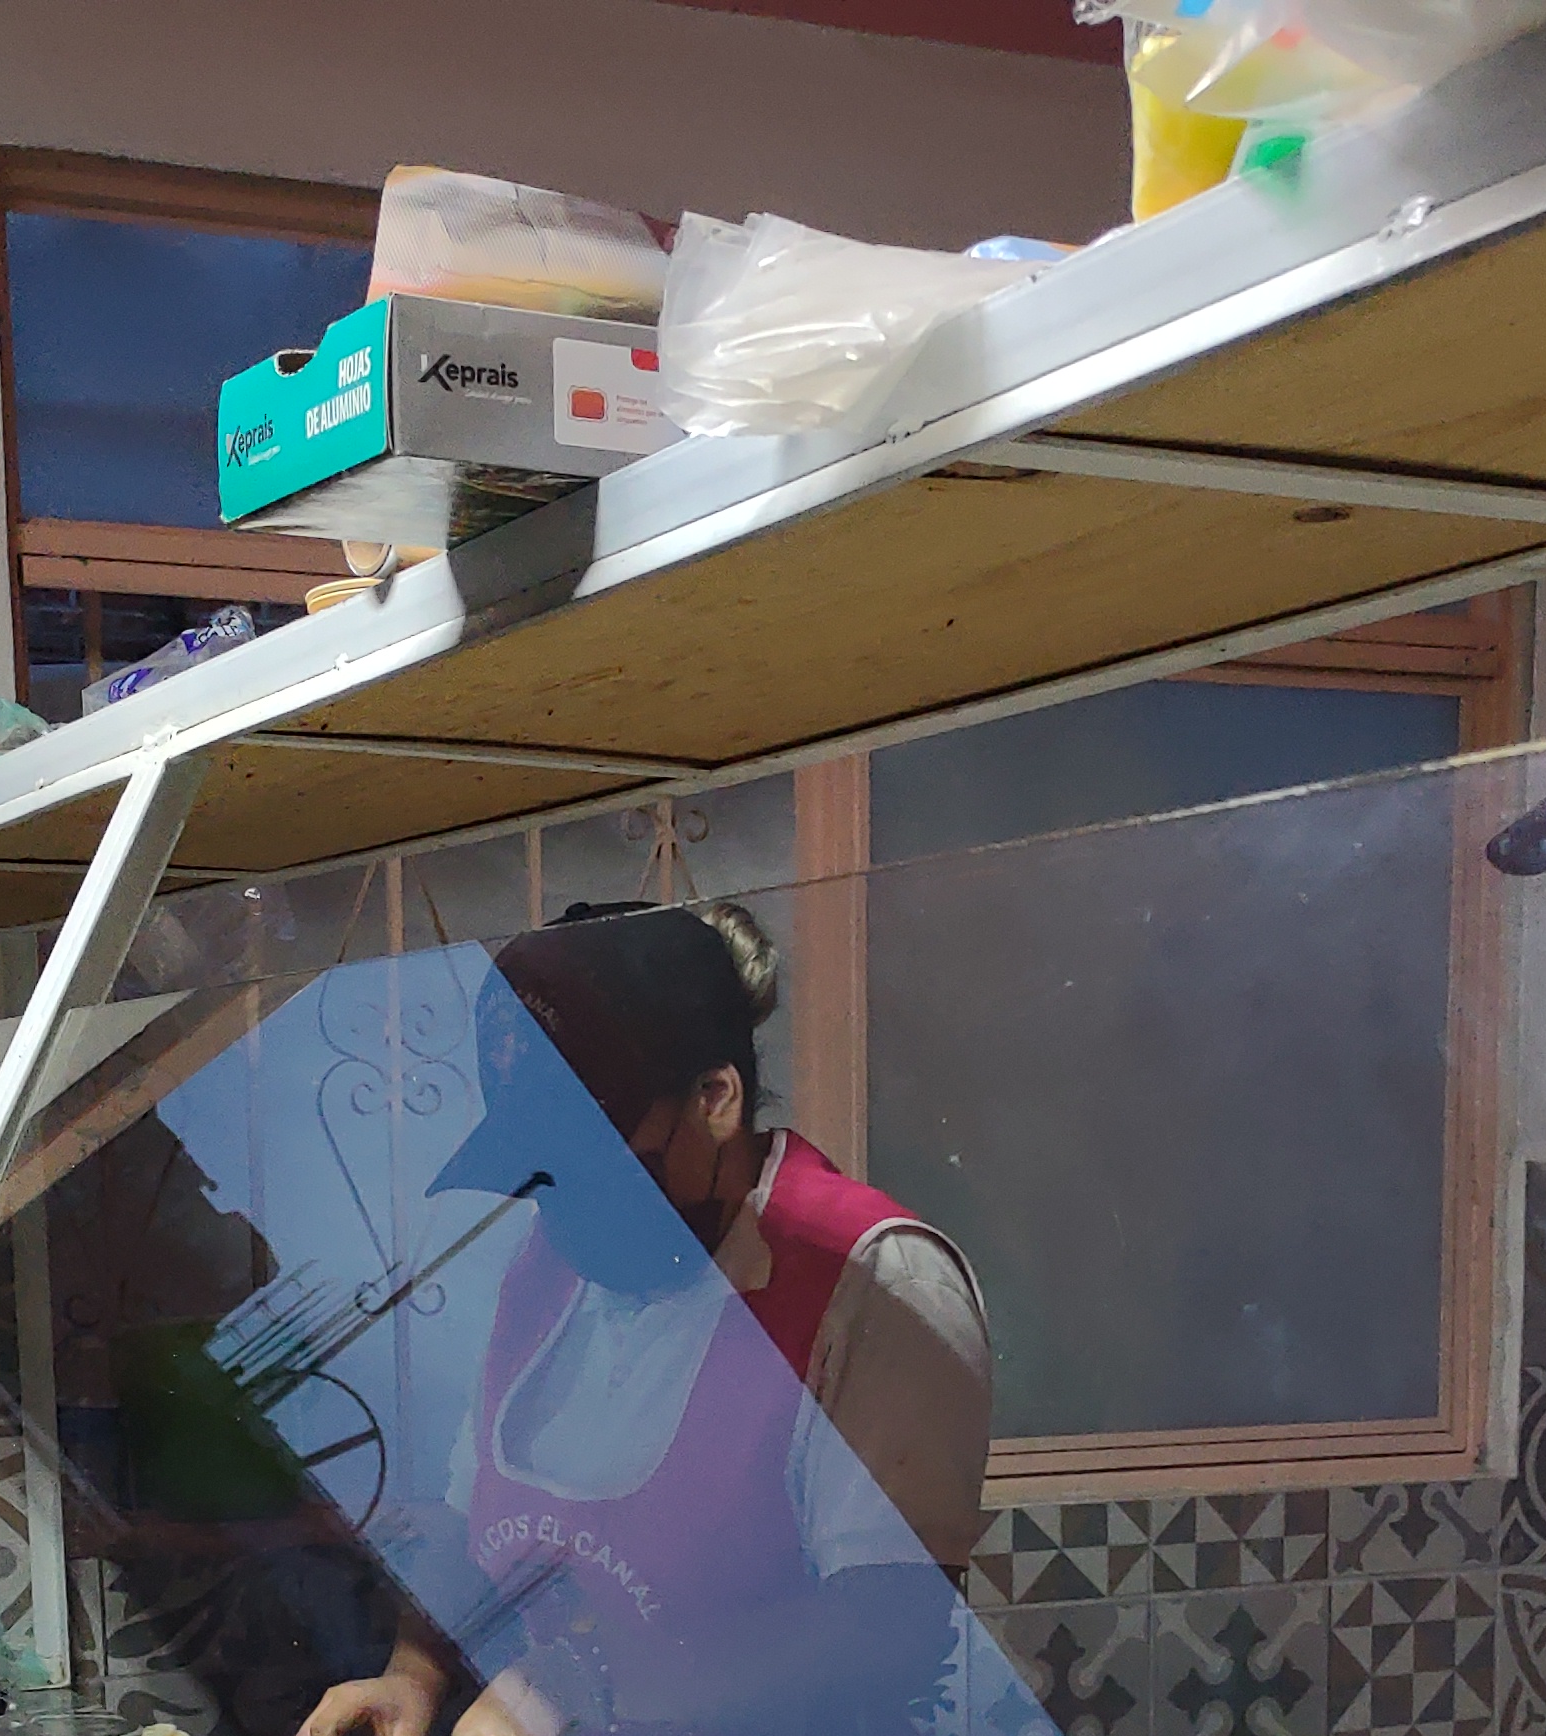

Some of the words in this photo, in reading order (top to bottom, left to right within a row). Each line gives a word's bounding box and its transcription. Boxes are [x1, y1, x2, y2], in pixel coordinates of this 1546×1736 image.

[338, 345, 373, 389] HOJAS
[417, 352, 520, 393] Keprais
[305, 405, 321, 440] DE
[320, 381, 373, 433] ALUMINIO
[478, 1515, 530, 1562] ACOS
[537, 1515, 567, 1547] EL
